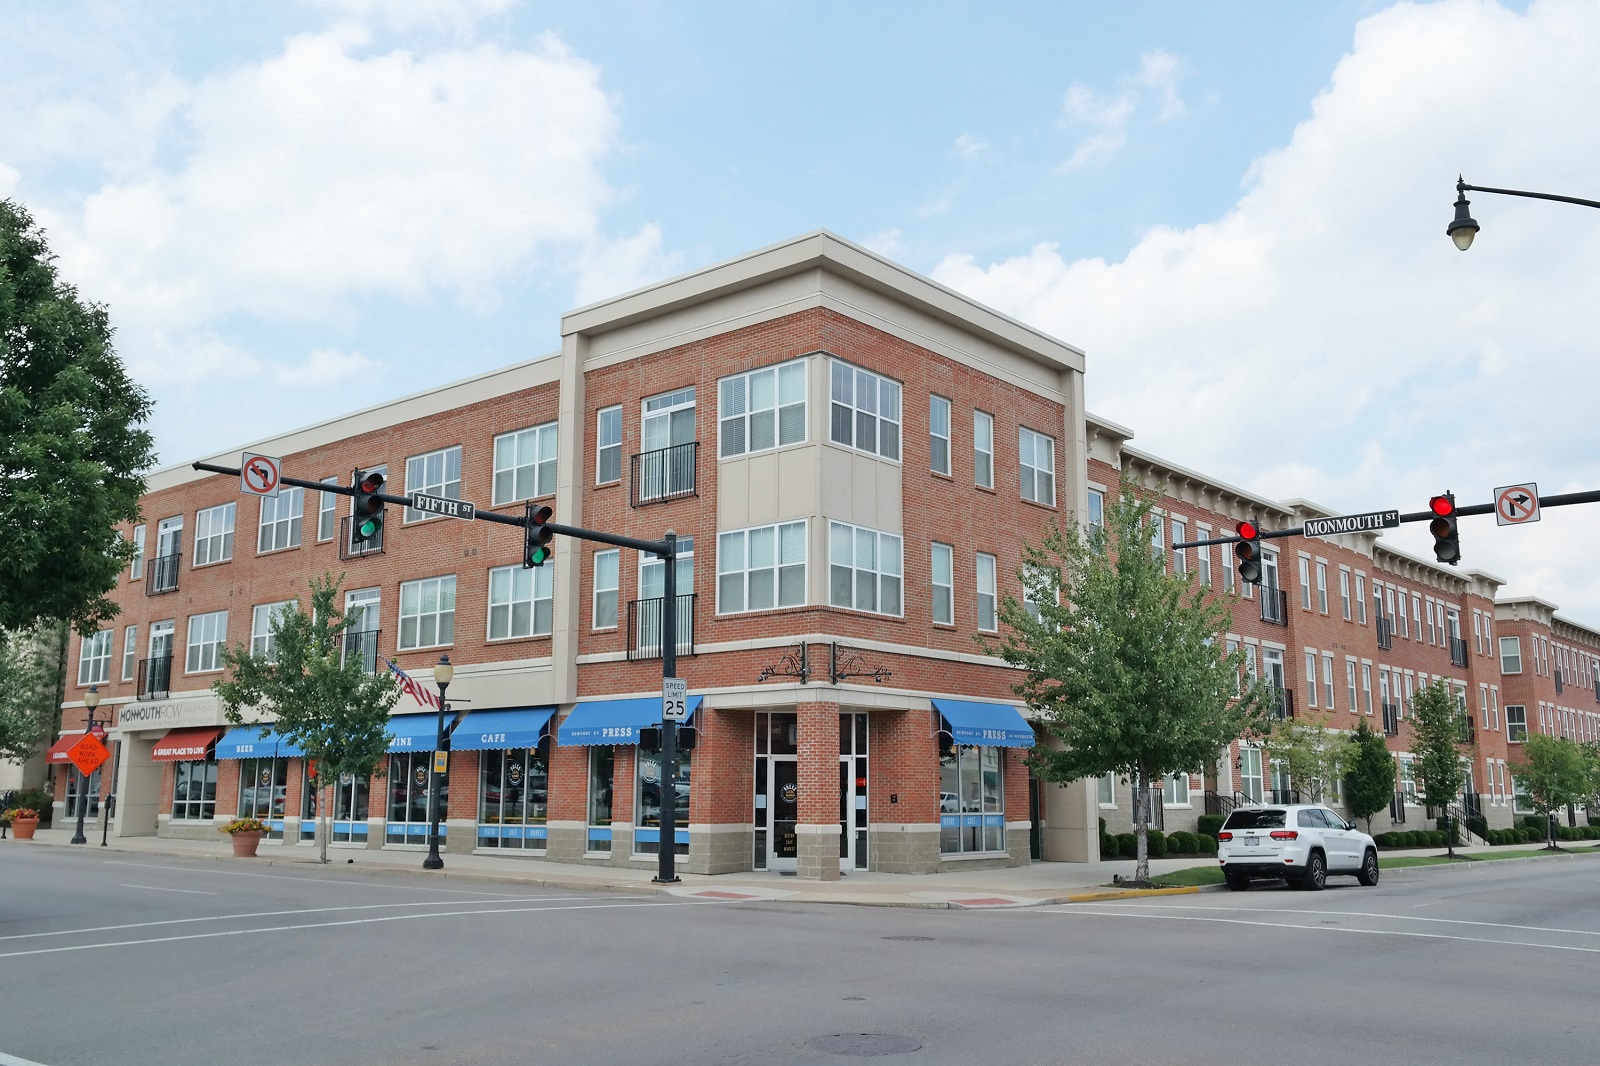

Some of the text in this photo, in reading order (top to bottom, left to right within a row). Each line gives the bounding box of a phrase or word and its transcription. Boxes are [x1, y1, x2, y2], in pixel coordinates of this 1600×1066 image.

[416, 495, 472, 516] FIFTH ST
[1306, 512, 1397, 536] MONMOUTH ST
[665, 682, 685, 690] SPEED
[665, 700, 685, 716] 25
[602, 727, 632, 738] PRESS
[982, 729, 1006, 740] PRESS
[390, 737, 412, 747] WINE
[481, 733, 506, 743] CAFE
[80, 743, 97, 751] ROAD
[153, 748, 158, 756] A
[158, 748, 172, 756] GREAT
[187, 747, 194, 755] TO
[236, 744, 254, 753] BEER
